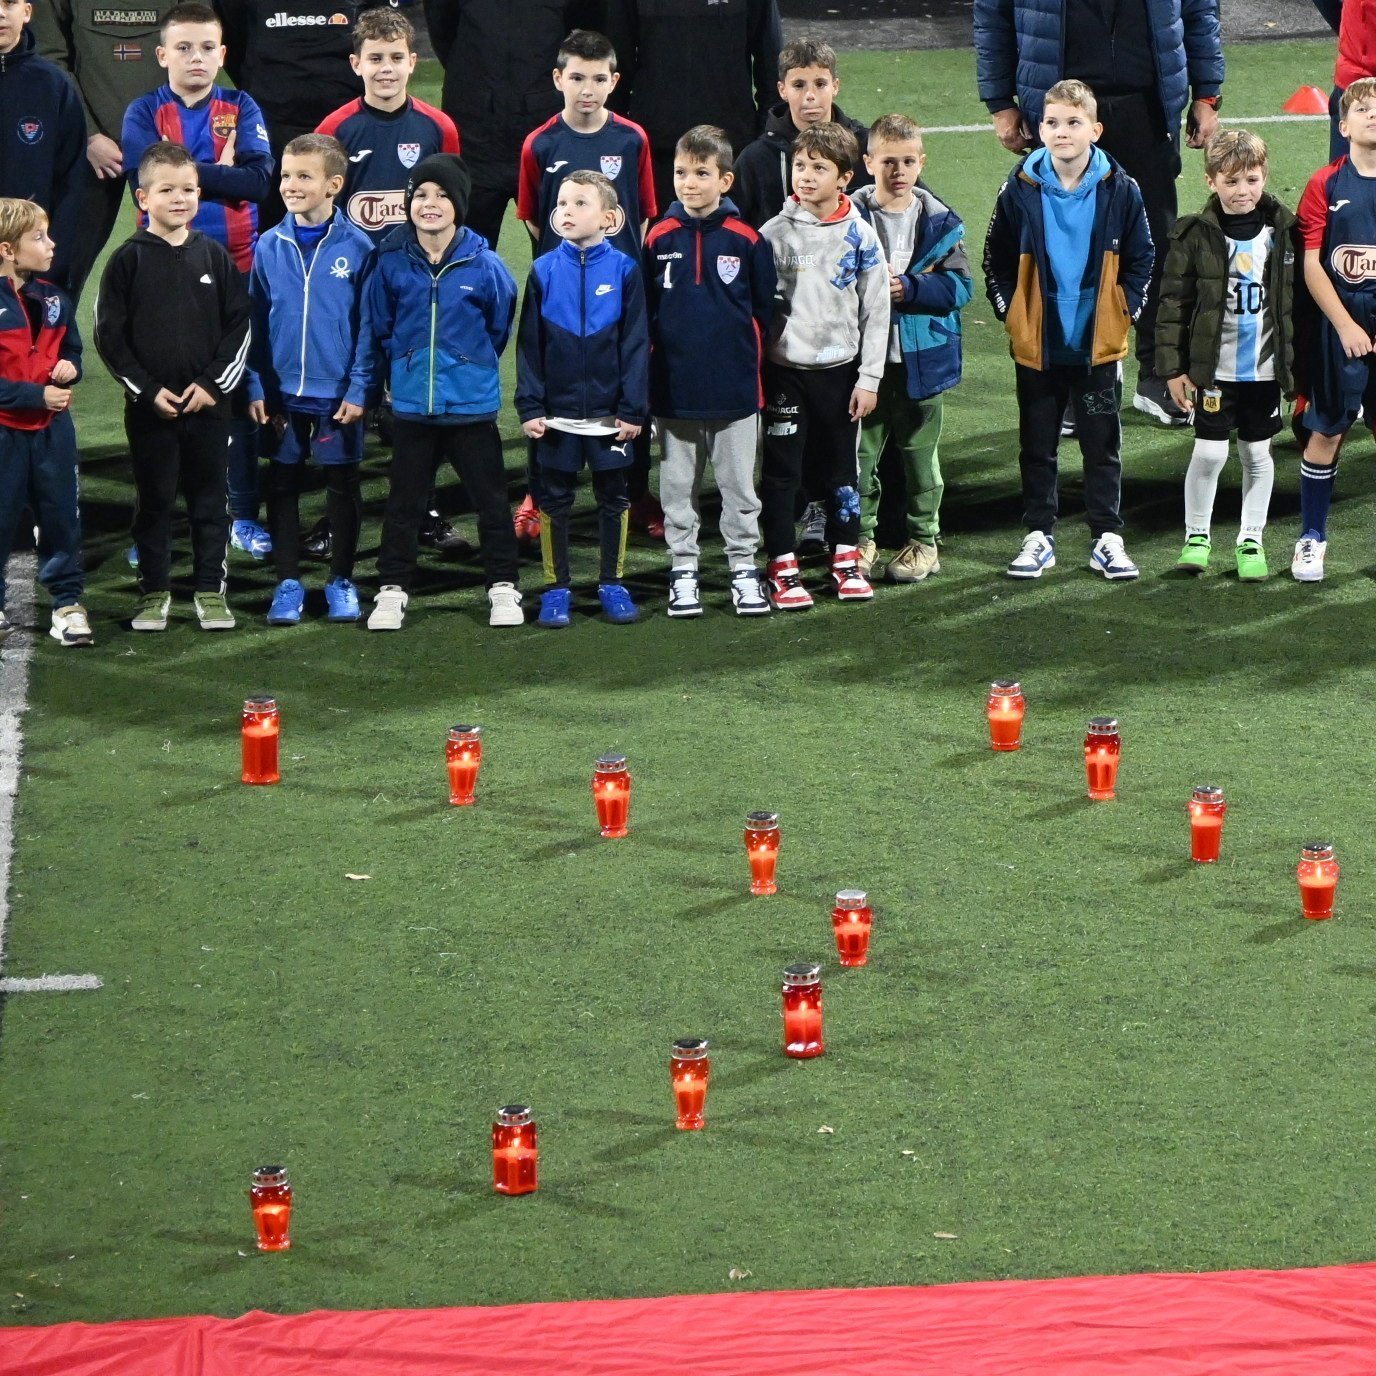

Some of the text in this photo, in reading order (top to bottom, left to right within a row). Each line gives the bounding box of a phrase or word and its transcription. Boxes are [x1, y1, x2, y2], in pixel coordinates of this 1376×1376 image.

[265, 12, 327, 28] ellesse
[358, 195, 406, 226] Tars
[1233, 281, 1264, 315] 10
